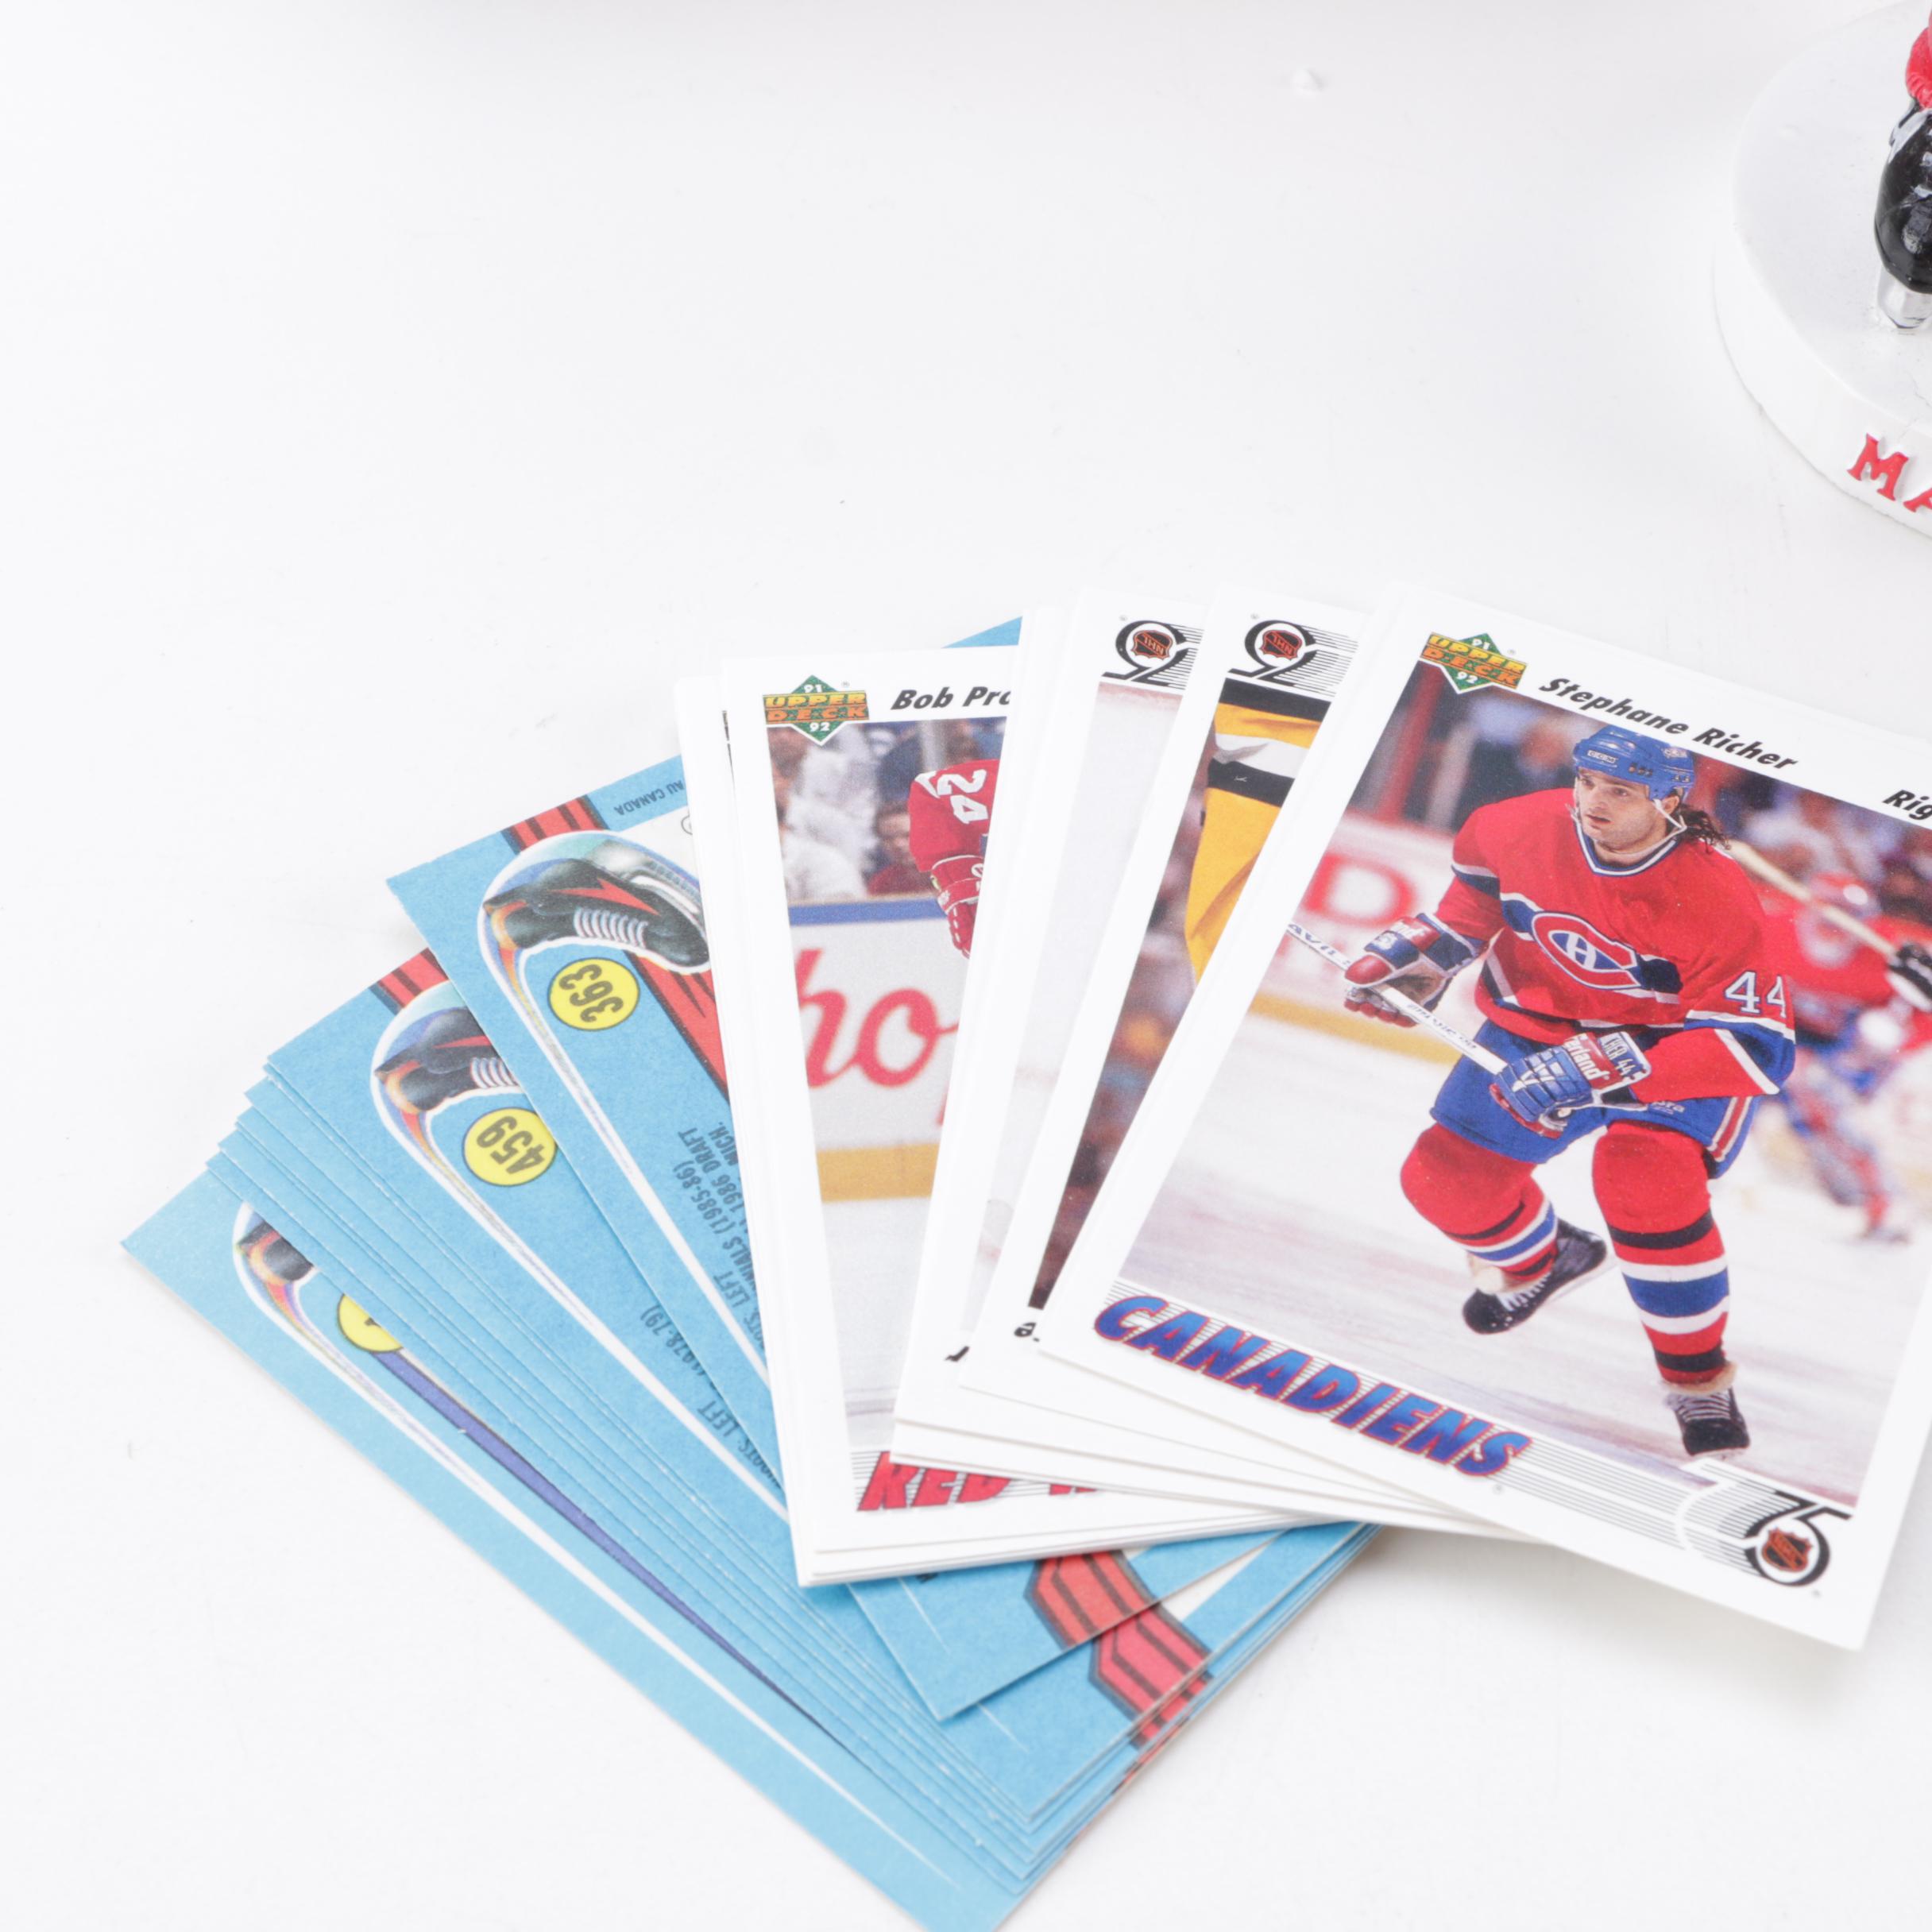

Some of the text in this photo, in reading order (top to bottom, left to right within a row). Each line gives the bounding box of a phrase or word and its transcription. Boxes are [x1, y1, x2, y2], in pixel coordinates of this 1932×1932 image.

[1429, 636, 1526, 674] UPPER
[1472, 638, 1490, 651] 91
[803, 684, 823, 694] 91
[1456, 671, 1478, 684] 92
[765, 693, 867, 708] UPPER
[891, 686, 954, 710] Bob
[809, 722, 830, 732] 92
[1539, 678, 1799, 770] Stephane Richer
[613, 779, 685, 816] AU CANADA
[558, 964, 624, 1022] 363
[1724, 969, 1787, 1018] 44
[477, 1115, 545, 1174] 459
[678, 1126, 721, 1174] DRAFT
[673, 1160, 737, 1235] (1985-86)
[713, 1271, 751, 1308] LEFT
[1094, 1295, 1533, 1477] CANADIENS
[697, 1401, 740, 1438] LEFT
